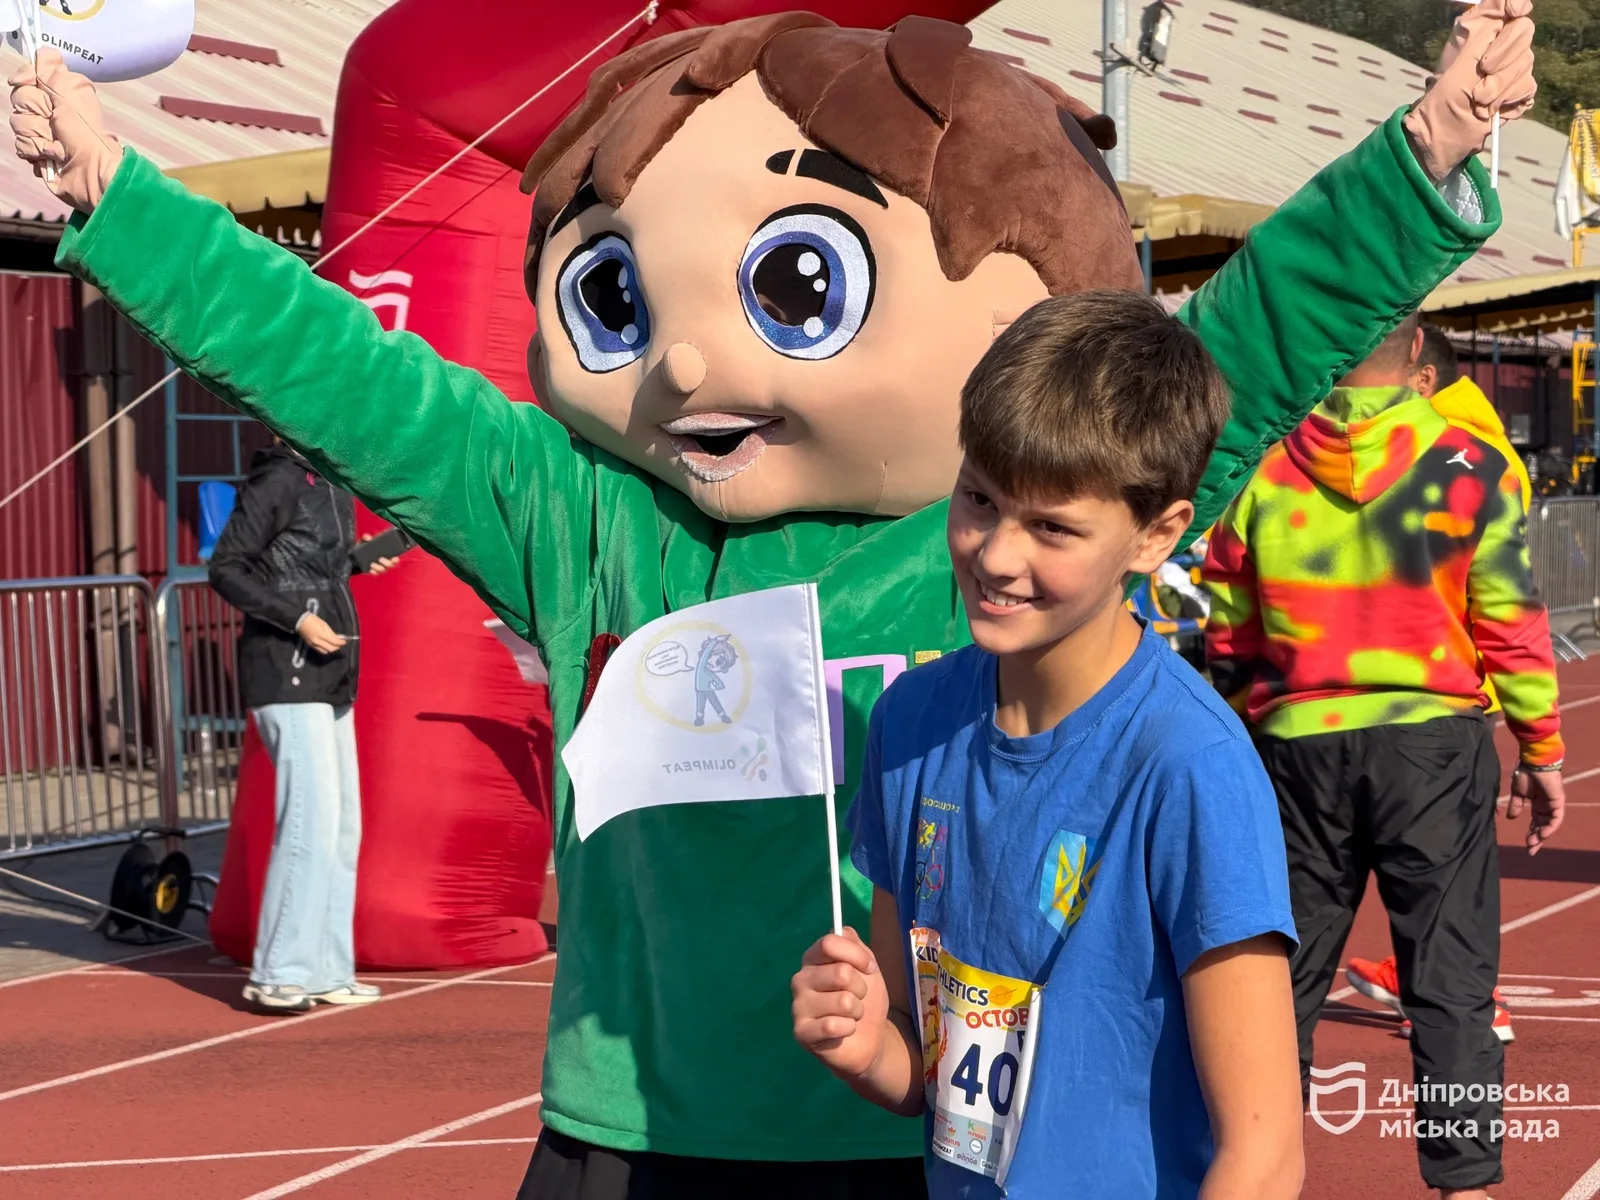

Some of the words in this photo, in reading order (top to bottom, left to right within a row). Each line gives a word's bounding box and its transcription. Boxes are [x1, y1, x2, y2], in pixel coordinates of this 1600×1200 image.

[41, 33, 104, 65] OLIMPEAT
[915, 946, 938, 963] KID
[937, 963, 989, 1006] THLETICS
[965, 1008, 1029, 1029] OCTOB
